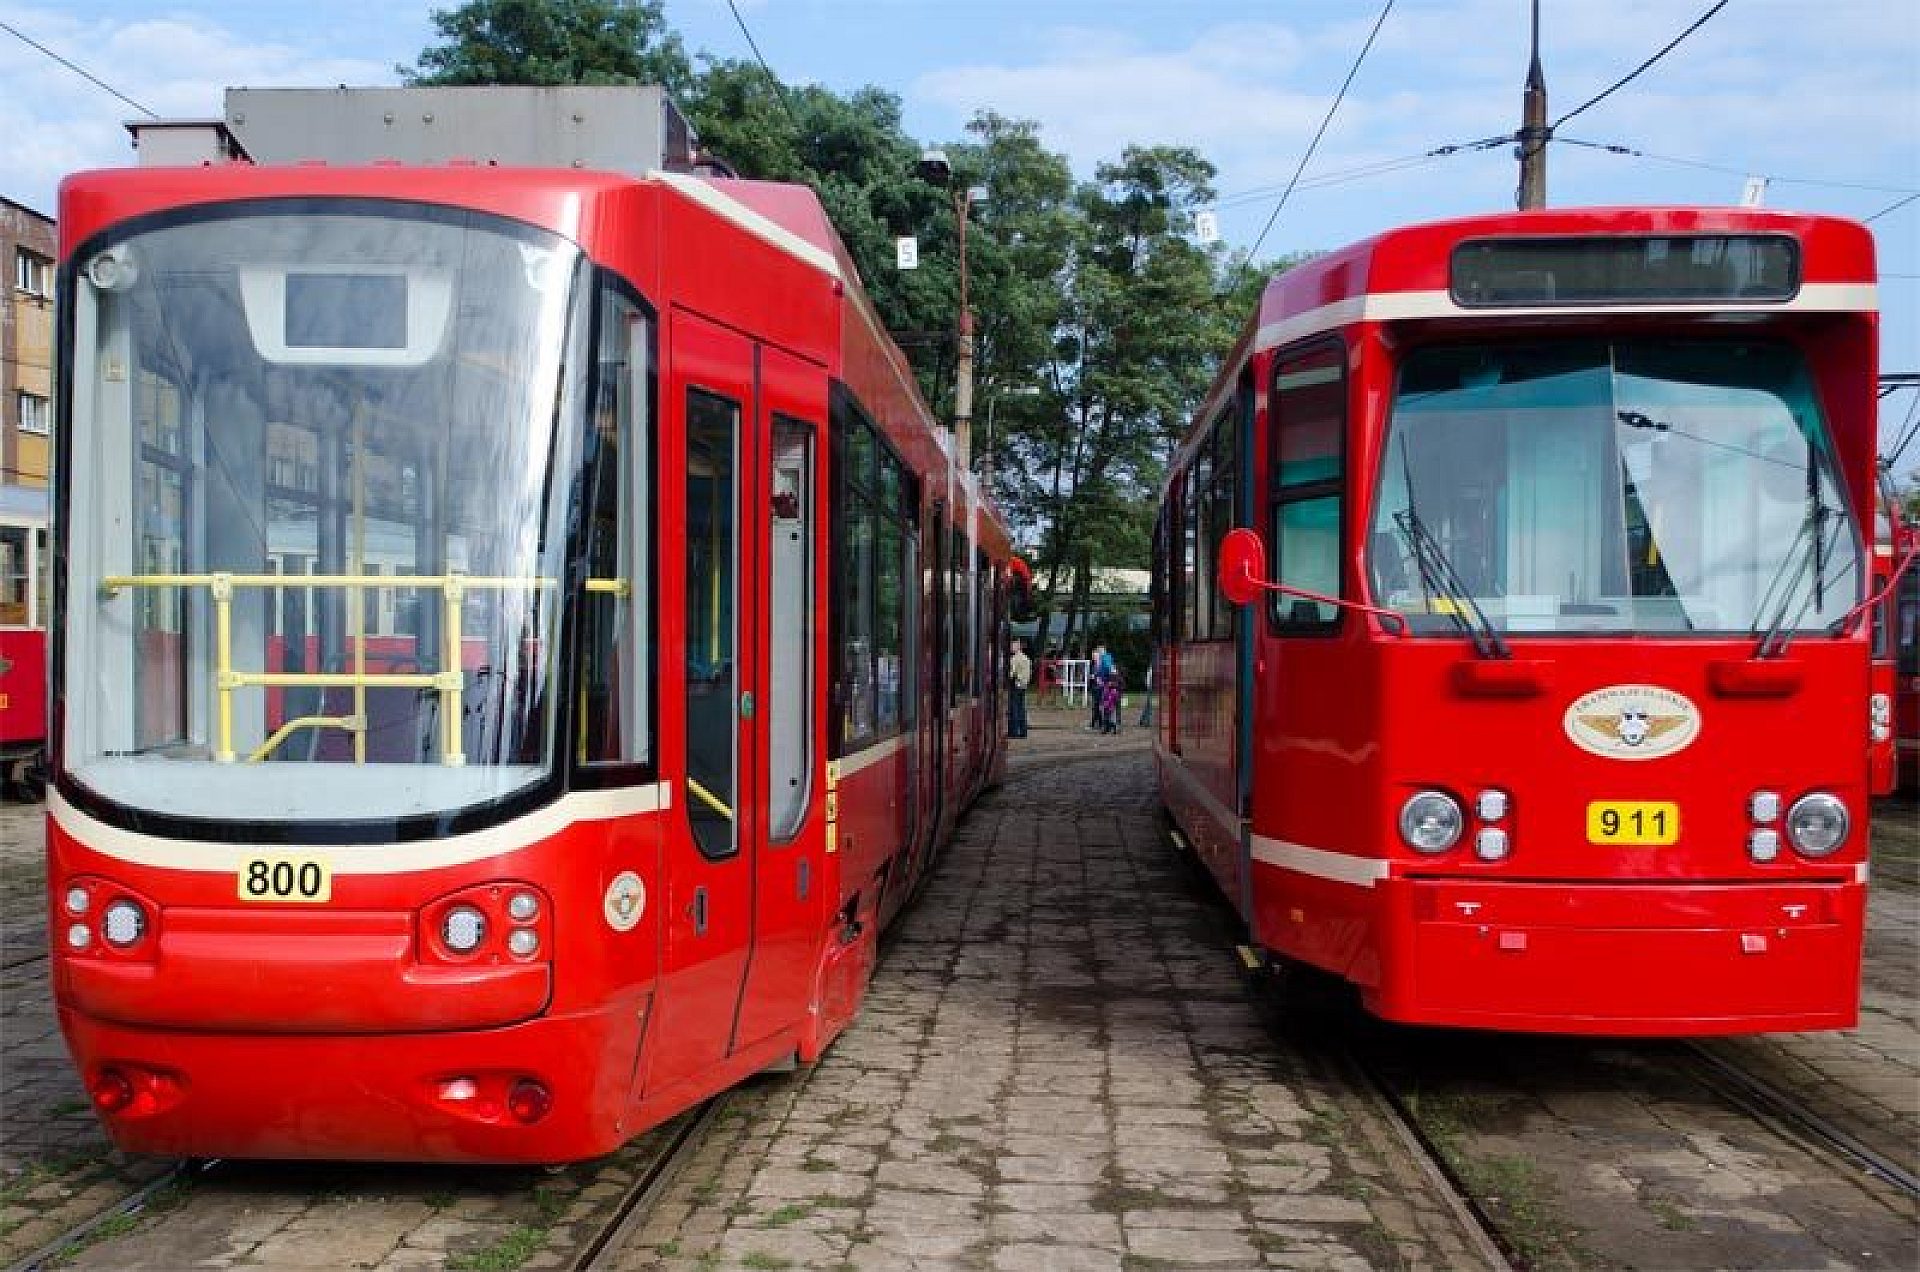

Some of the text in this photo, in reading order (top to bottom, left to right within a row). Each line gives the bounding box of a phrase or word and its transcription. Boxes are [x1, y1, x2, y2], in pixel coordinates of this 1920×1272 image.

[902, 244, 912, 263] 5
[1601, 809, 1664, 836] 911
[247, 860, 321, 896] 800
